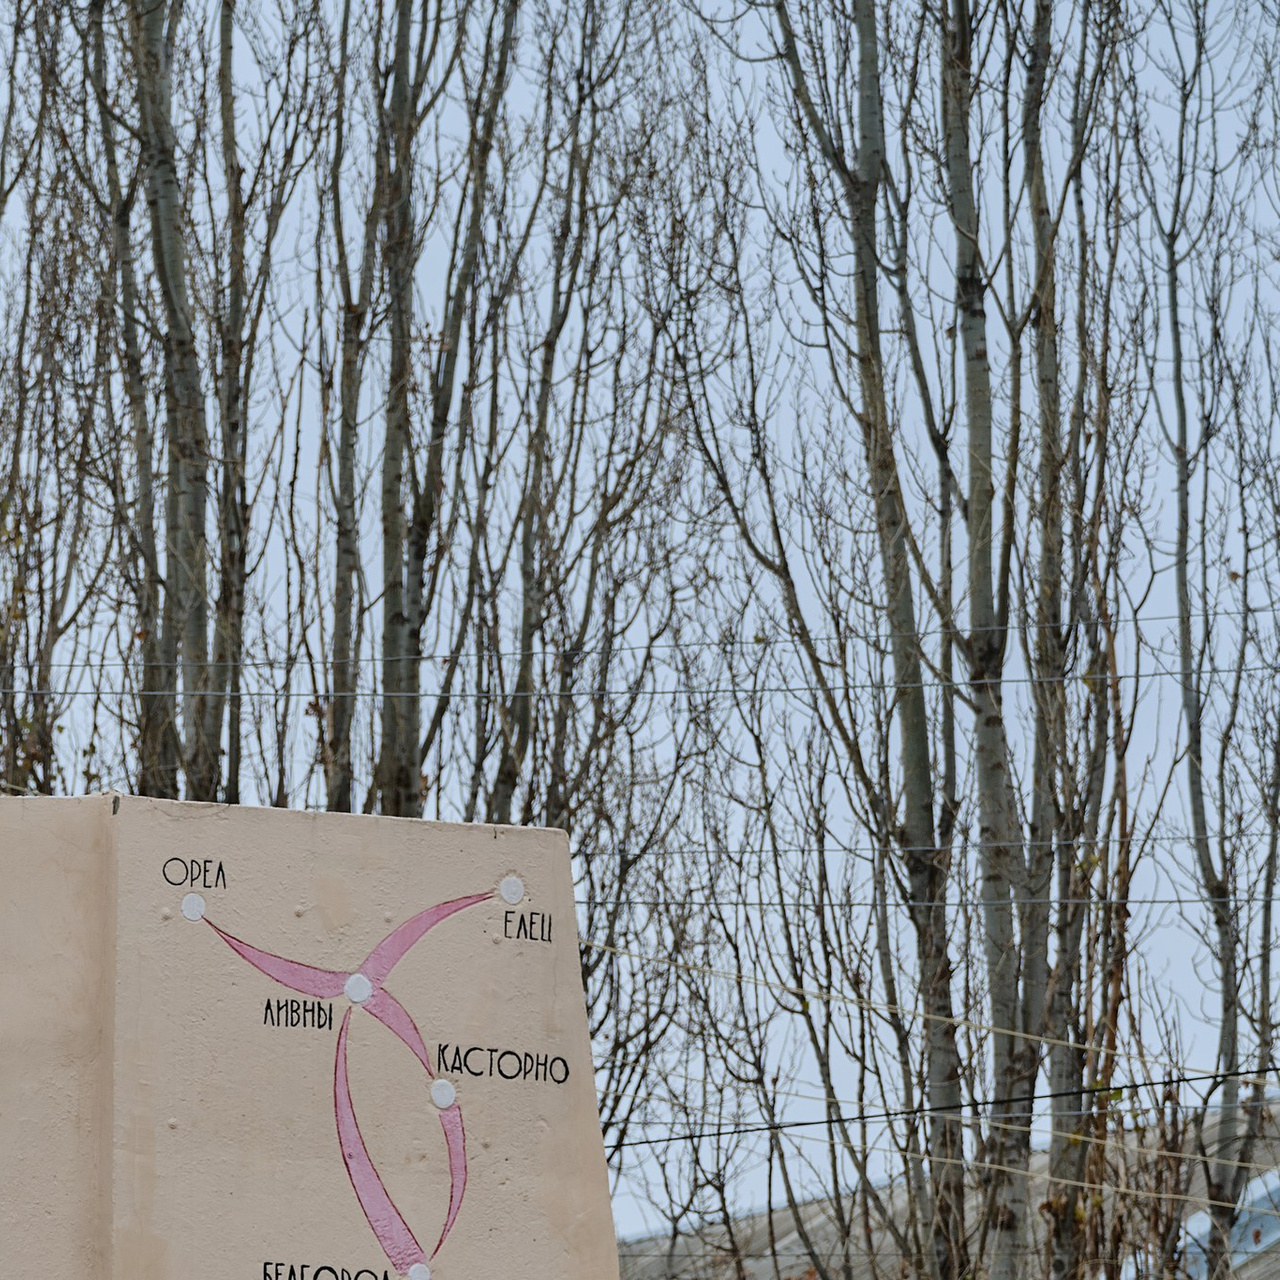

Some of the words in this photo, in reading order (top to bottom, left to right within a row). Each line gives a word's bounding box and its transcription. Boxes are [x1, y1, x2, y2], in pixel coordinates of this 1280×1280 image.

[162, 857, 227, 890] ОРЕЛ
[504, 910, 552, 944] ЕЛЕЦ
[263, 998, 333, 1031] ЛИВНЫ
[437, 1043, 570, 1085] КАСТОРНО
